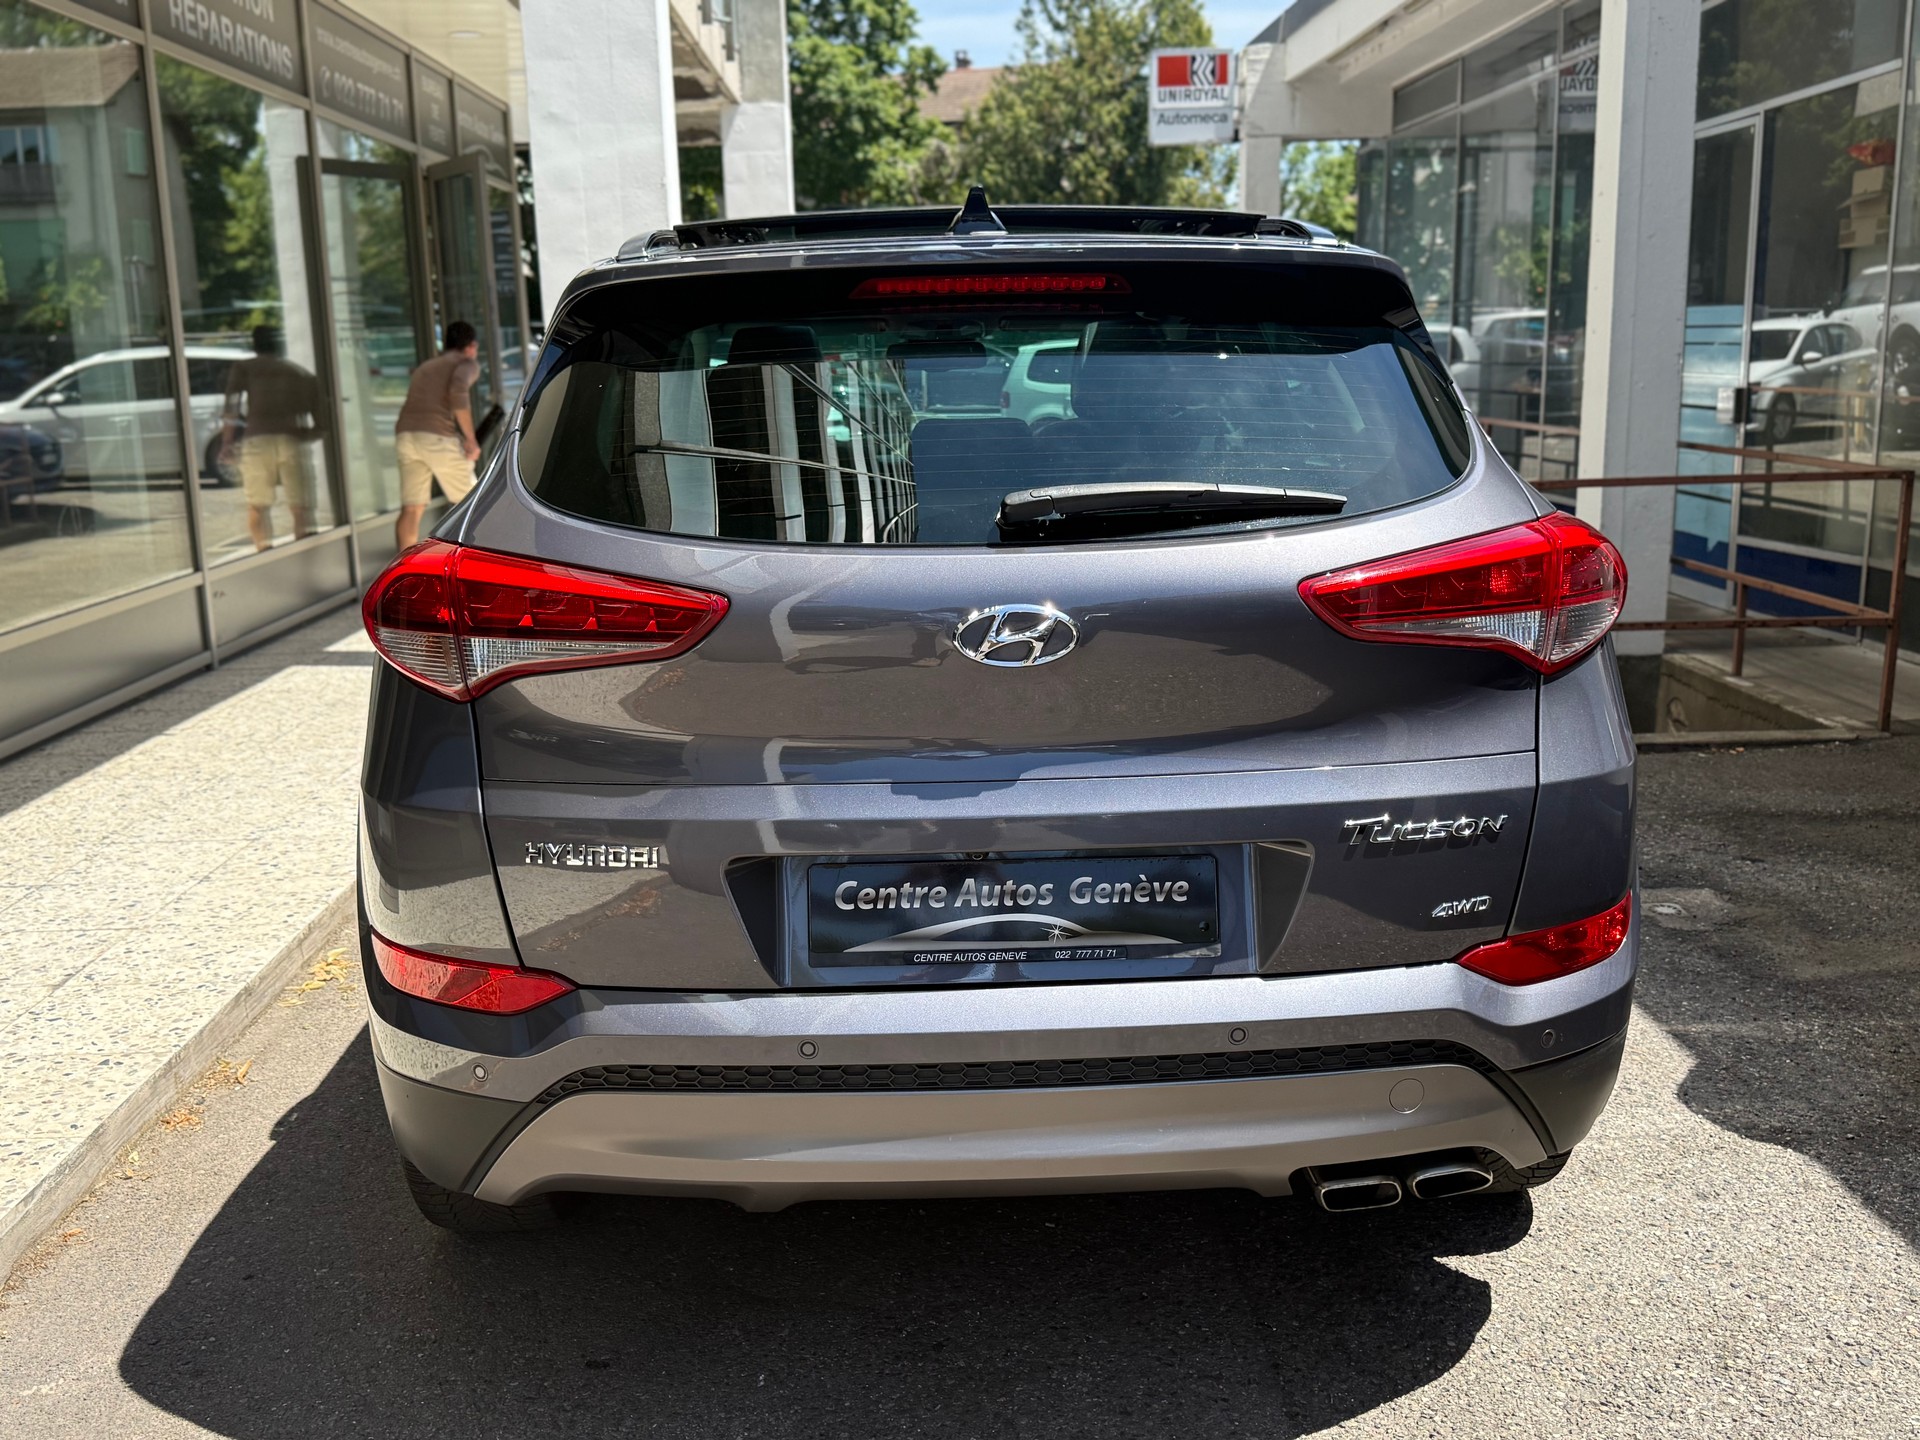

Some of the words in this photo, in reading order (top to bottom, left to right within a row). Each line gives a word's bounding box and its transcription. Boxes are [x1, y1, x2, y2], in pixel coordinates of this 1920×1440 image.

[1158, 88, 1229, 102] UNIROYAL
[1157, 112, 1229, 126] Automeca
[525, 841, 659, 868] HYUNDAI
[834, 880, 948, 911] Centre
[954, 877, 1054, 907] Autos
[1069, 874, 1190, 905] Genève
[1431, 894, 1493, 919] 4WD
[913, 952, 953, 963] CENTRE
[953, 952, 987, 962] AUTOS
[987, 951, 1028, 961] GENEVE
[1054, 950, 1071, 959] 022
[1075, 949, 1092, 959] 777
[1093, 949, 1104, 958] 71
[1106, 948, 1117, 958] 71
